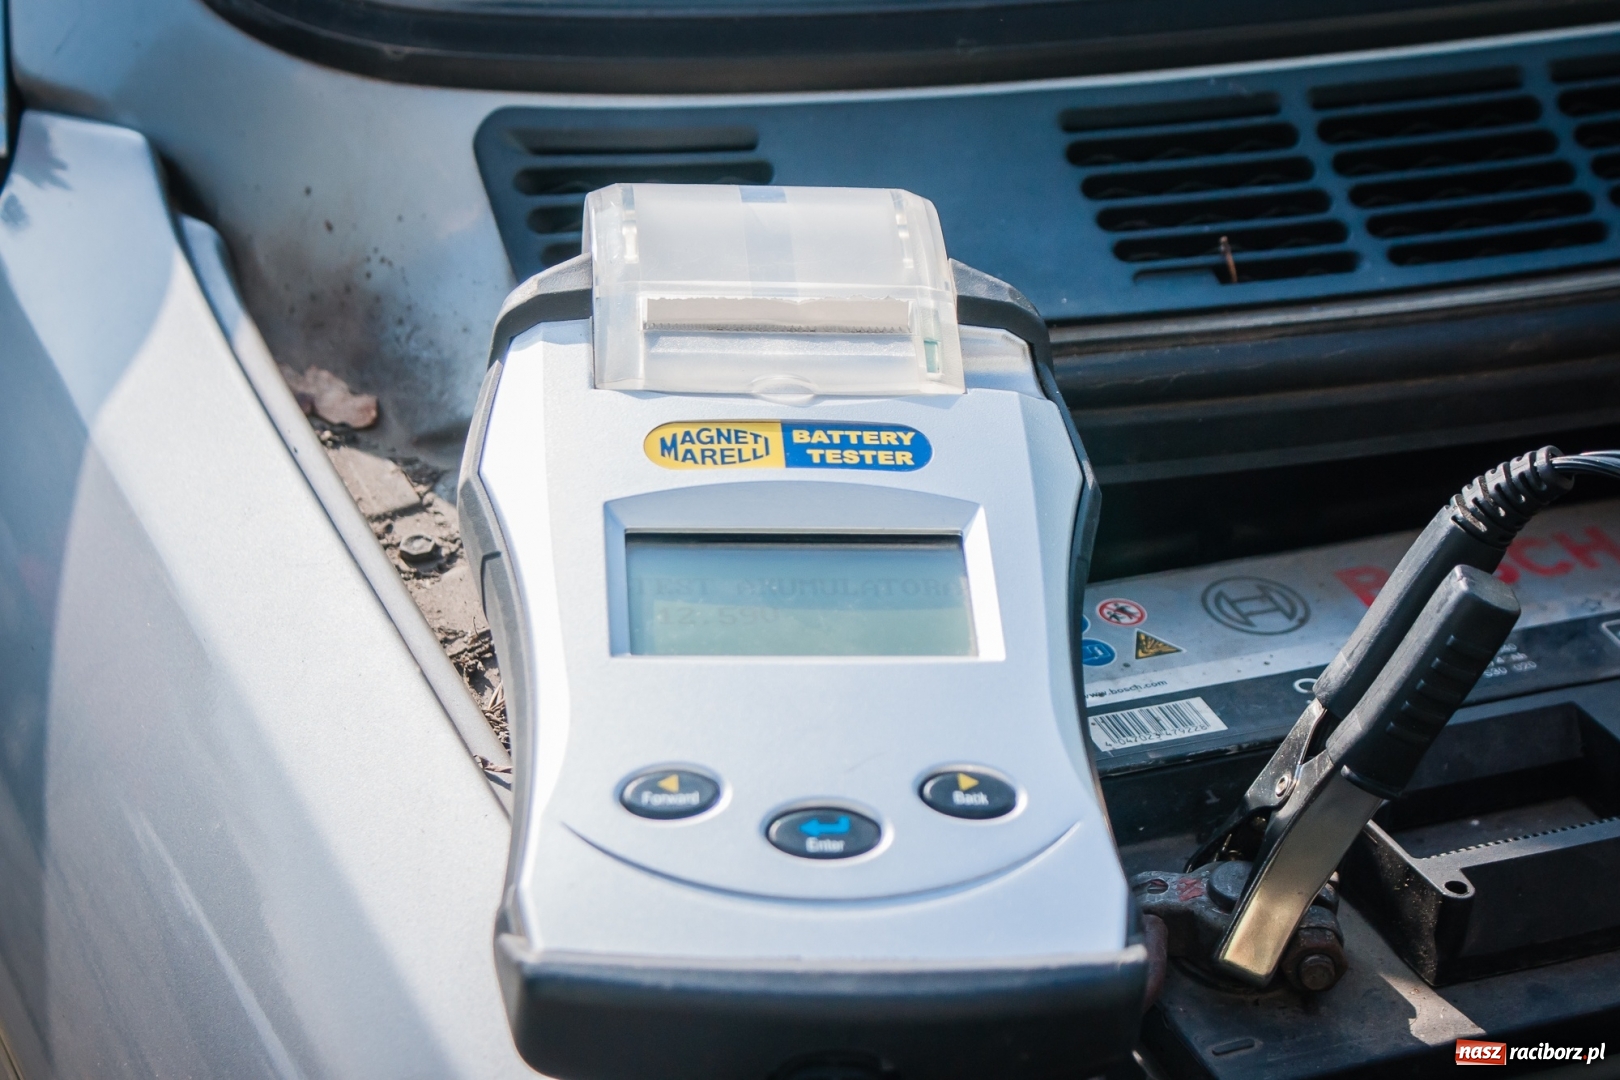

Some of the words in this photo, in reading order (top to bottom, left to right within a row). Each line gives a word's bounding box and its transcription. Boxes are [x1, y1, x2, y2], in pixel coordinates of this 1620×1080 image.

[660, 428, 770, 456] MAGNETI
[792, 430, 915, 445] BATTERY
[660, 436, 770, 465] MARELLI
[807, 448, 915, 466] TESTER
[1334, 526, 1620, 607] BCH
[632, 578, 710, 596] TEST
[1165, 724, 1208, 737] 479228
[641, 790, 700, 807] Forward
[952, 790, 990, 806] Back
[805, 837, 845, 853] Enter
